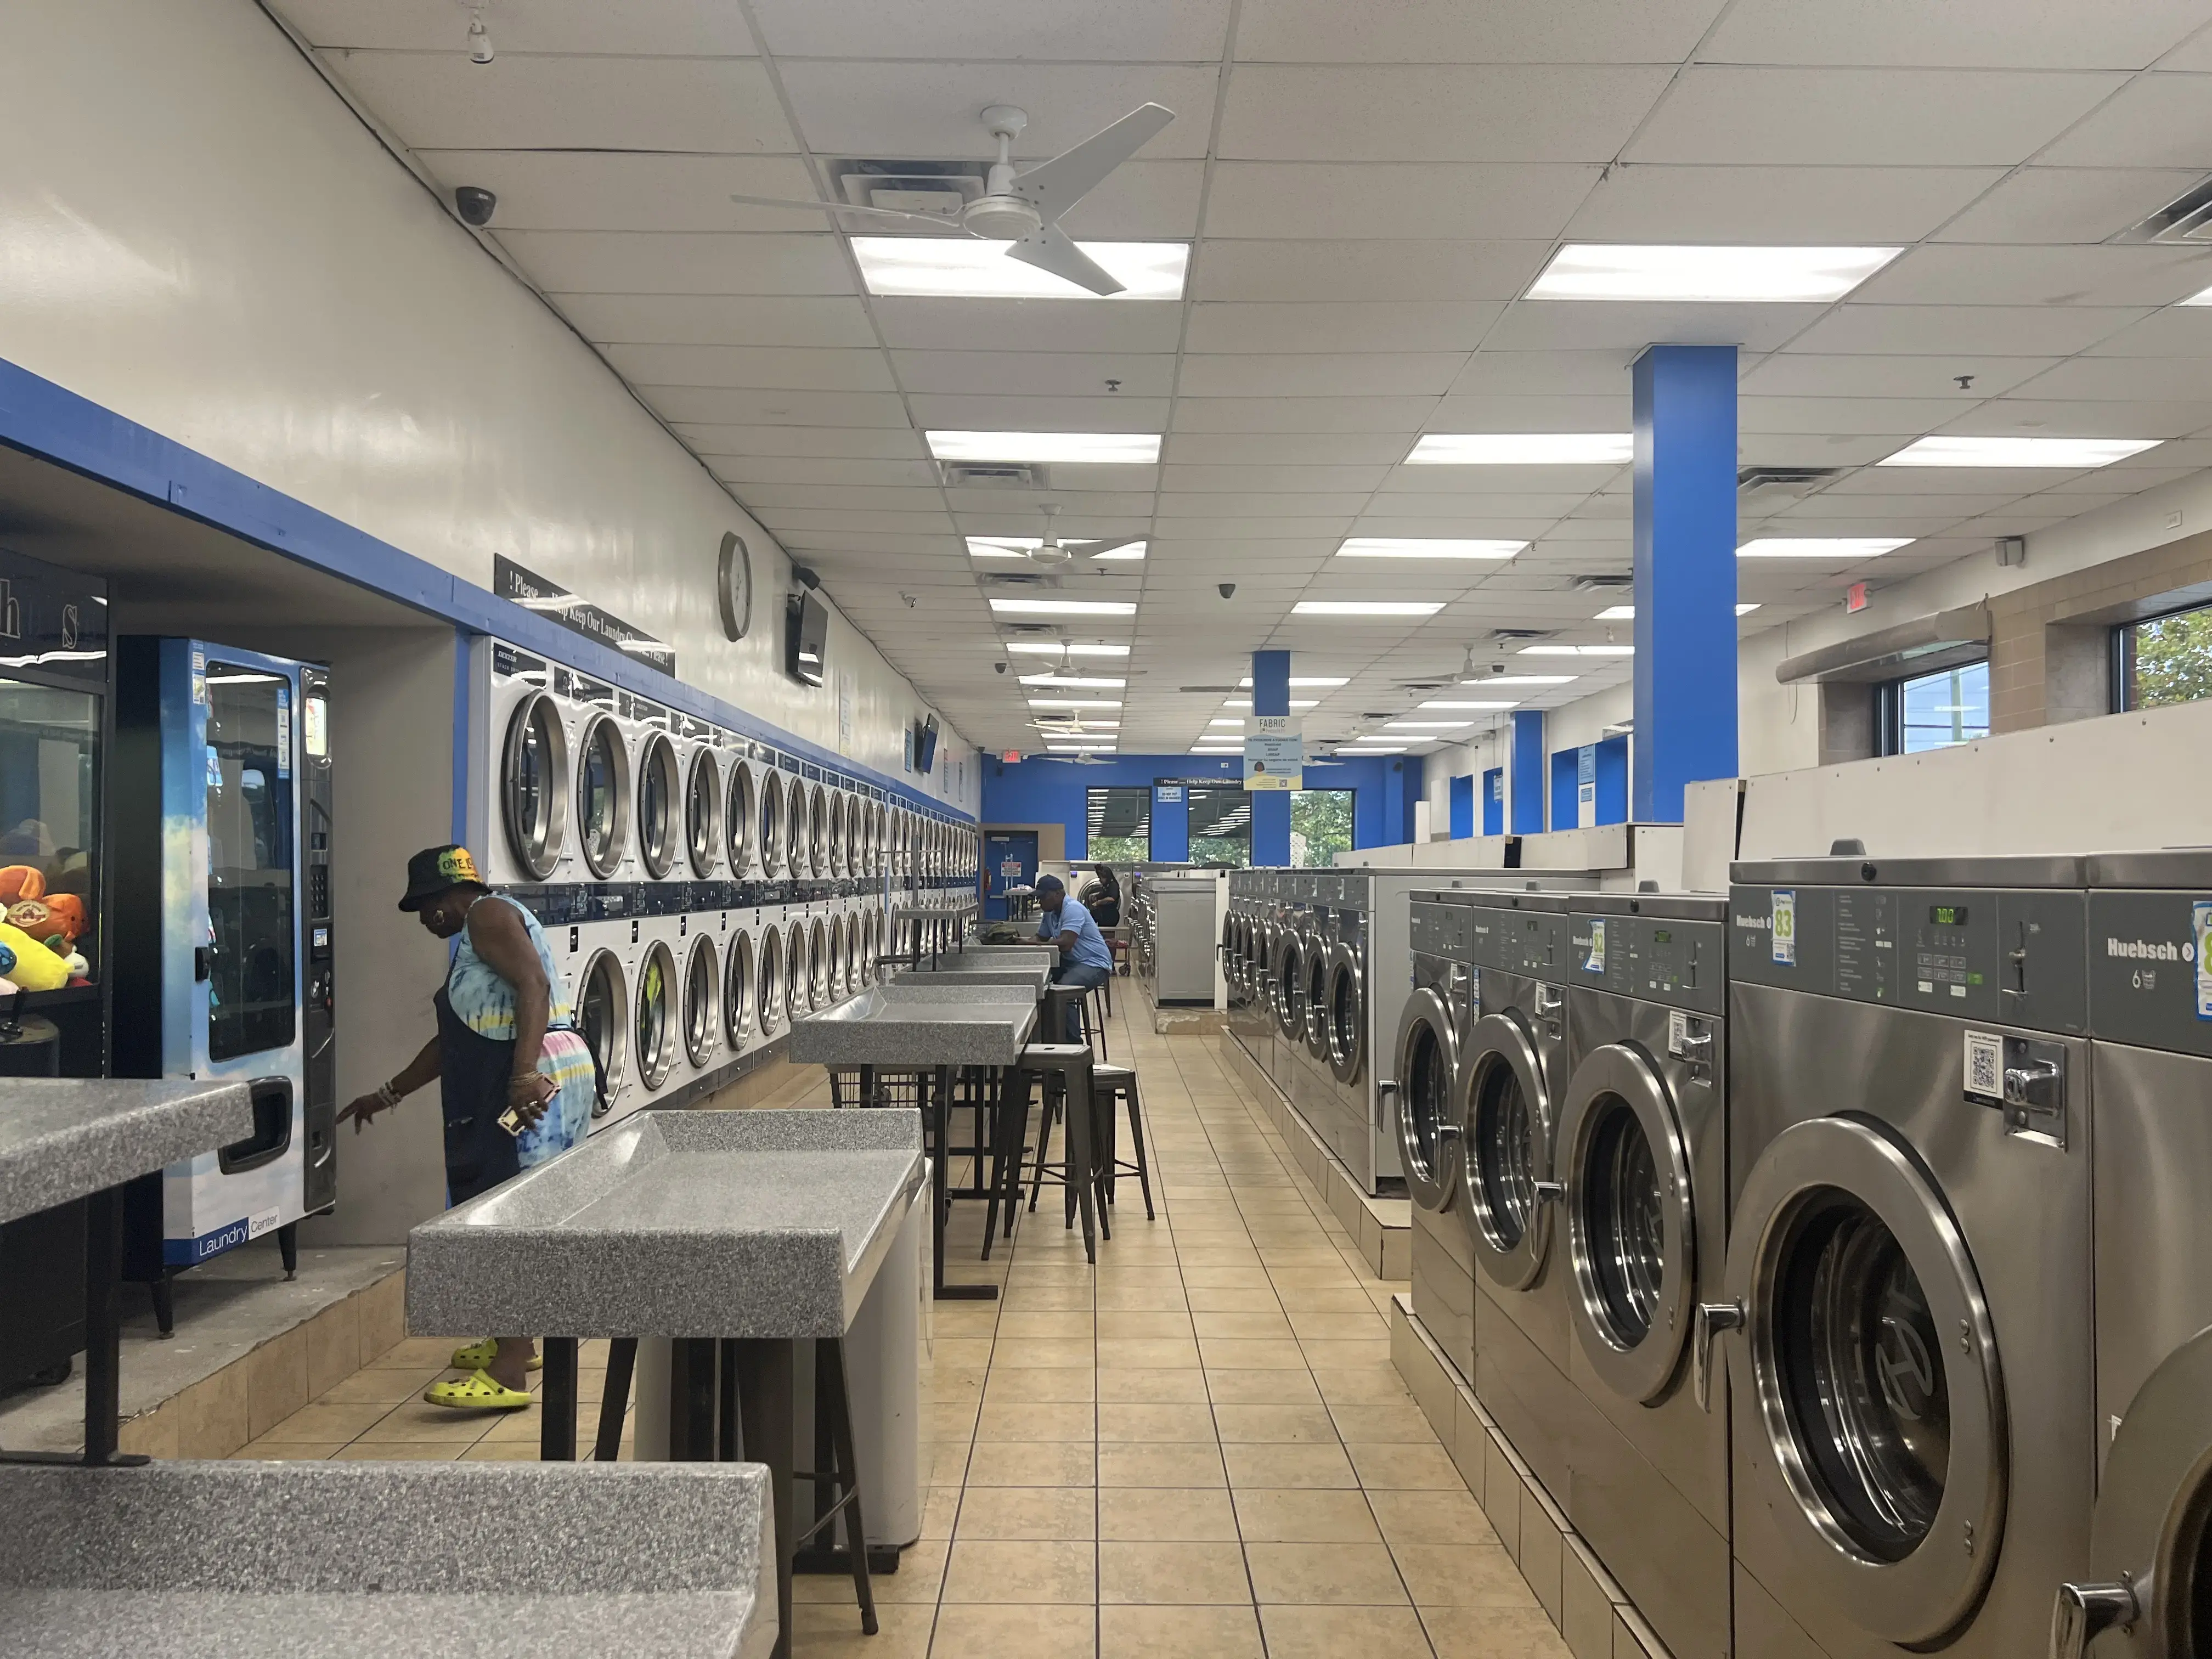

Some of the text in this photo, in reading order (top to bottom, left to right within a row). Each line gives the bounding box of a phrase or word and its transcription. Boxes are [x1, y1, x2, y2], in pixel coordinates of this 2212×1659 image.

[515, 573, 539, 599] Please
[570, 606, 586, 630] Keep
[588, 611, 600, 632] Our
[498, 651, 517, 663] DEXTER
[1260, 719, 1285, 727] FABRIC
[442, 858, 466, 870] ONE
[1736, 915, 1765, 929] Huebsch
[1775, 909, 1792, 937] 83
[2108, 938, 2178, 961] Huebsch
[2132, 969, 2142, 989] 6
[200, 1214, 278, 1256] Laundry Center
